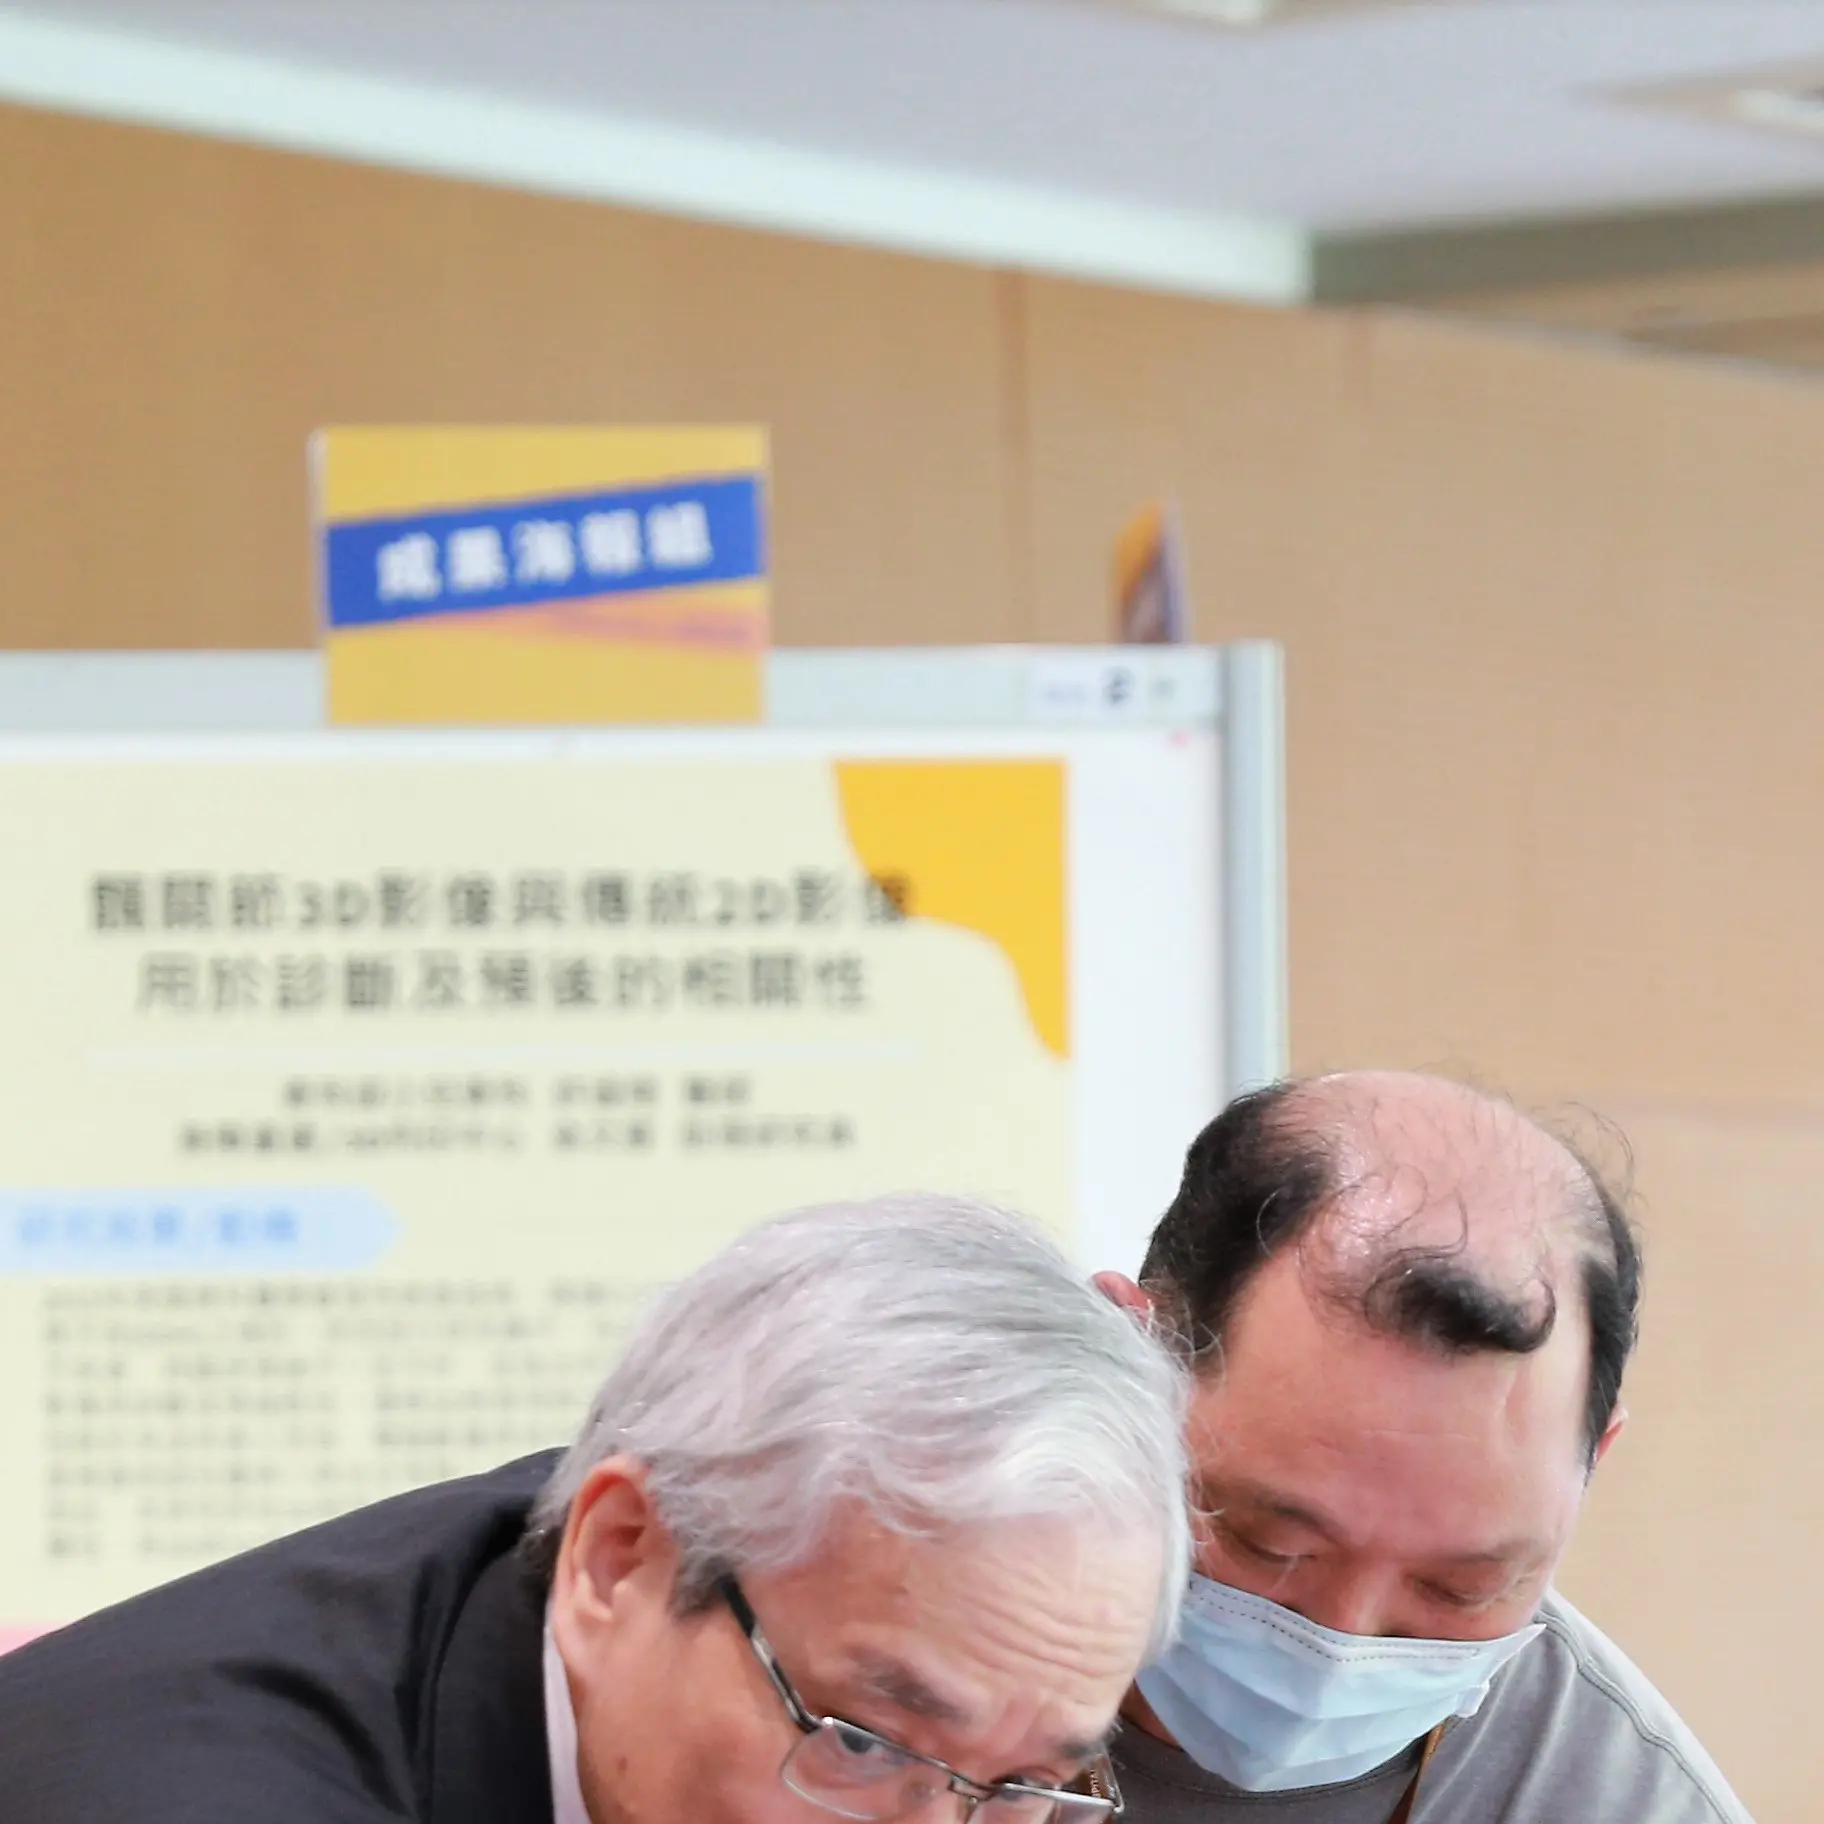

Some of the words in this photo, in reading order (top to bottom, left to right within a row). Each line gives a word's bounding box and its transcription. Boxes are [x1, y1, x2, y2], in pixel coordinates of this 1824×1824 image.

[377, 501, 713, 604] 成果海報組
[136, 952, 874, 1016] 用於診斷及預後的相關性
